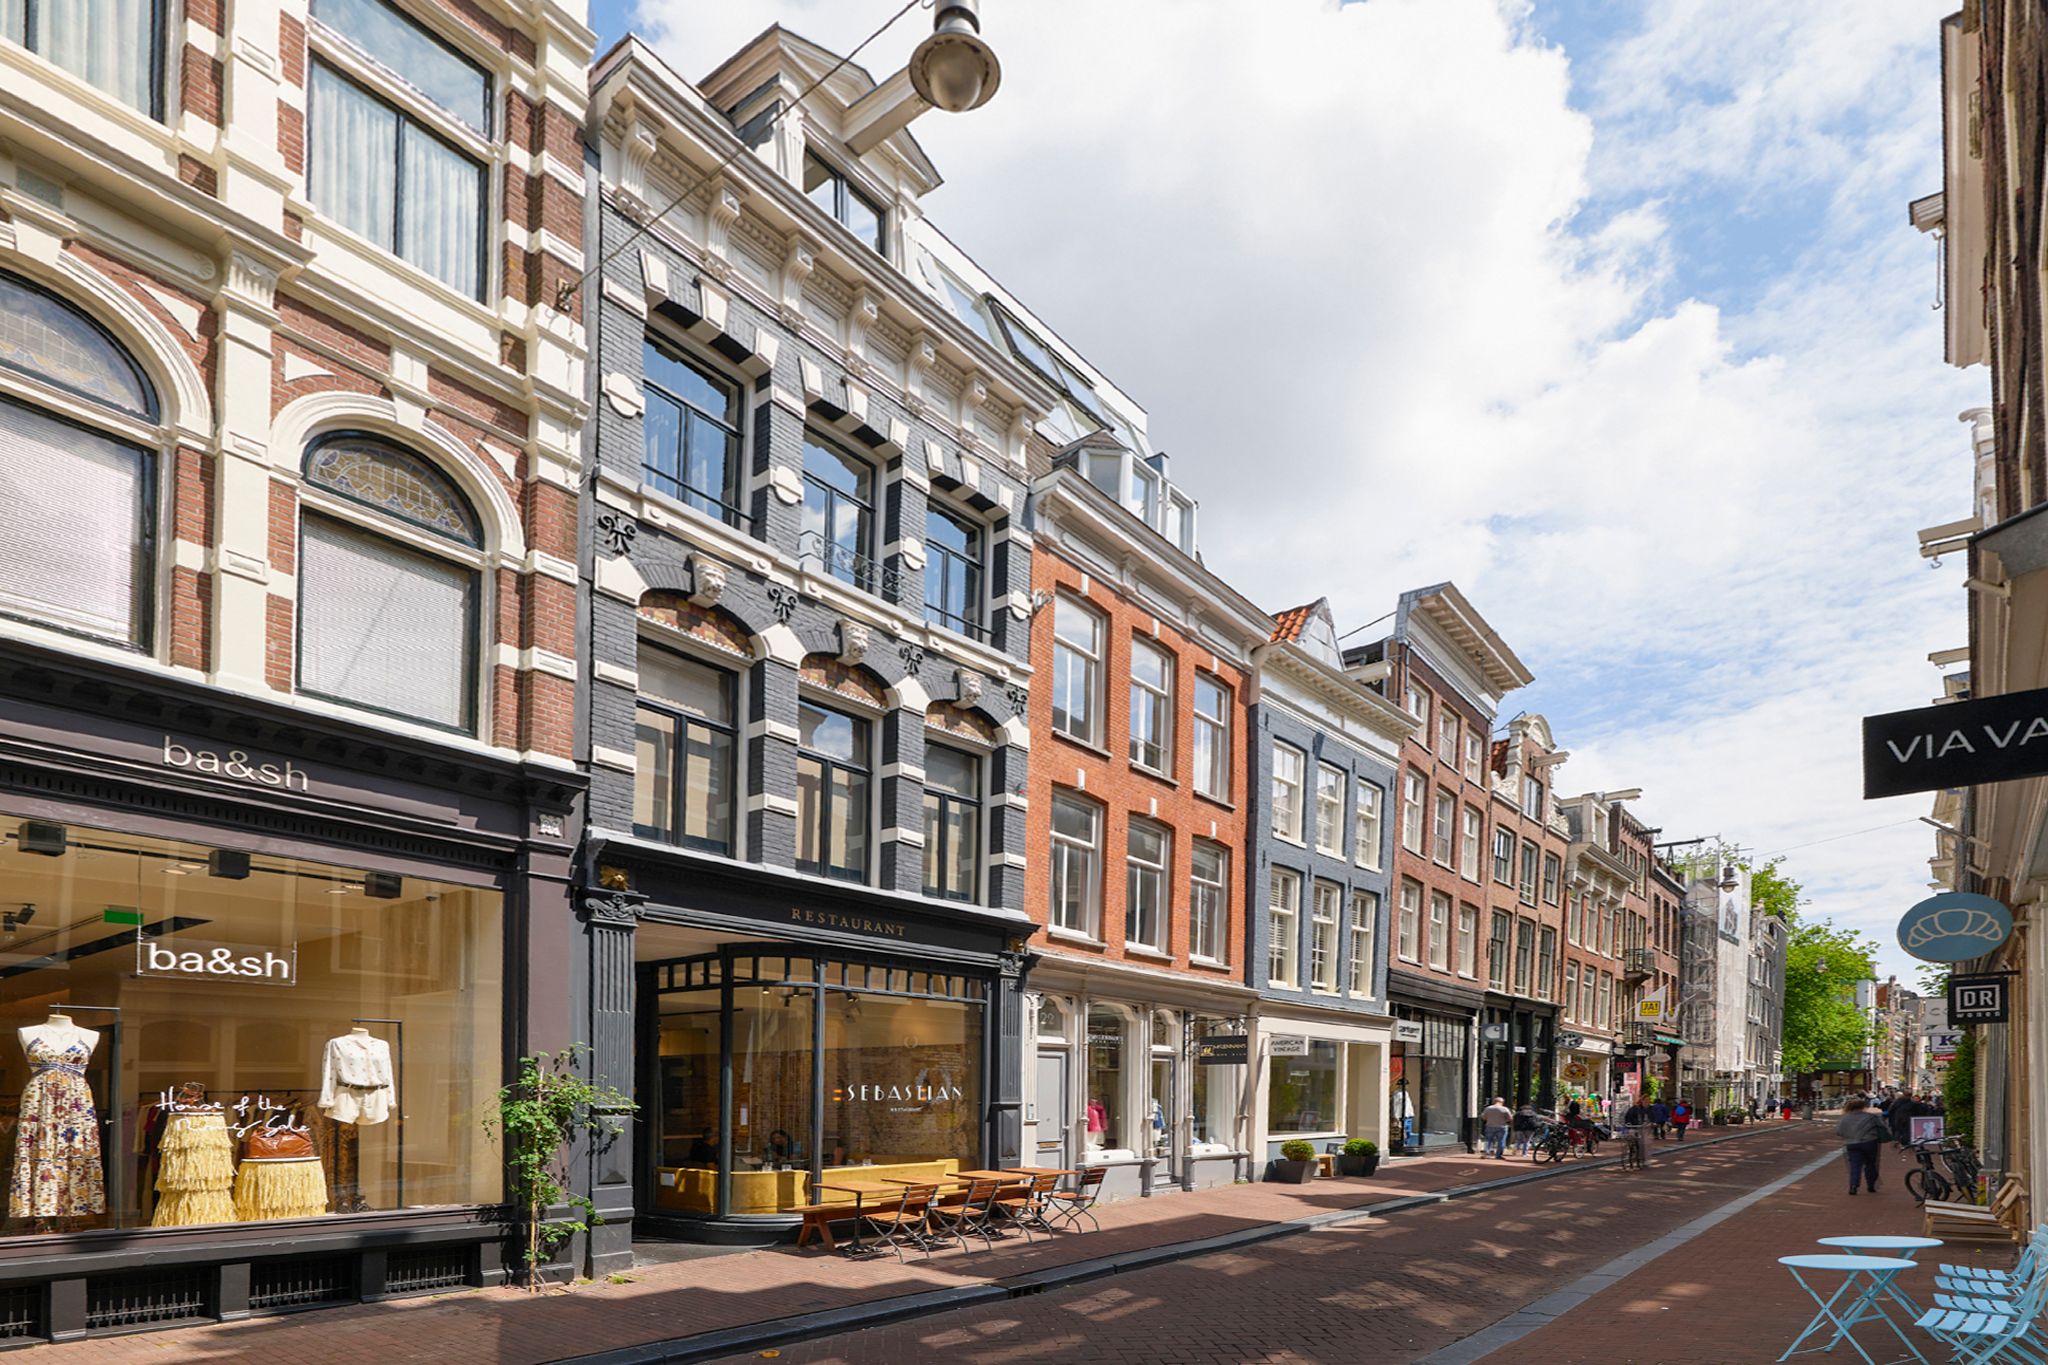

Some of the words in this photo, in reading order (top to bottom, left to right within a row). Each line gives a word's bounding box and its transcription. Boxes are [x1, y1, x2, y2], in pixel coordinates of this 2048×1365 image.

[1886, 729, 1976, 763] VIA
[163, 735, 309, 791] ba&sh
[791, 908, 905, 936] RESTAURANT
[149, 942, 289, 979] ba&sh
[1963, 990, 1994, 1007] DR
[1040, 1012, 1055, 1025] 22
[847, 1084, 963, 1101] SEBASTIAN
